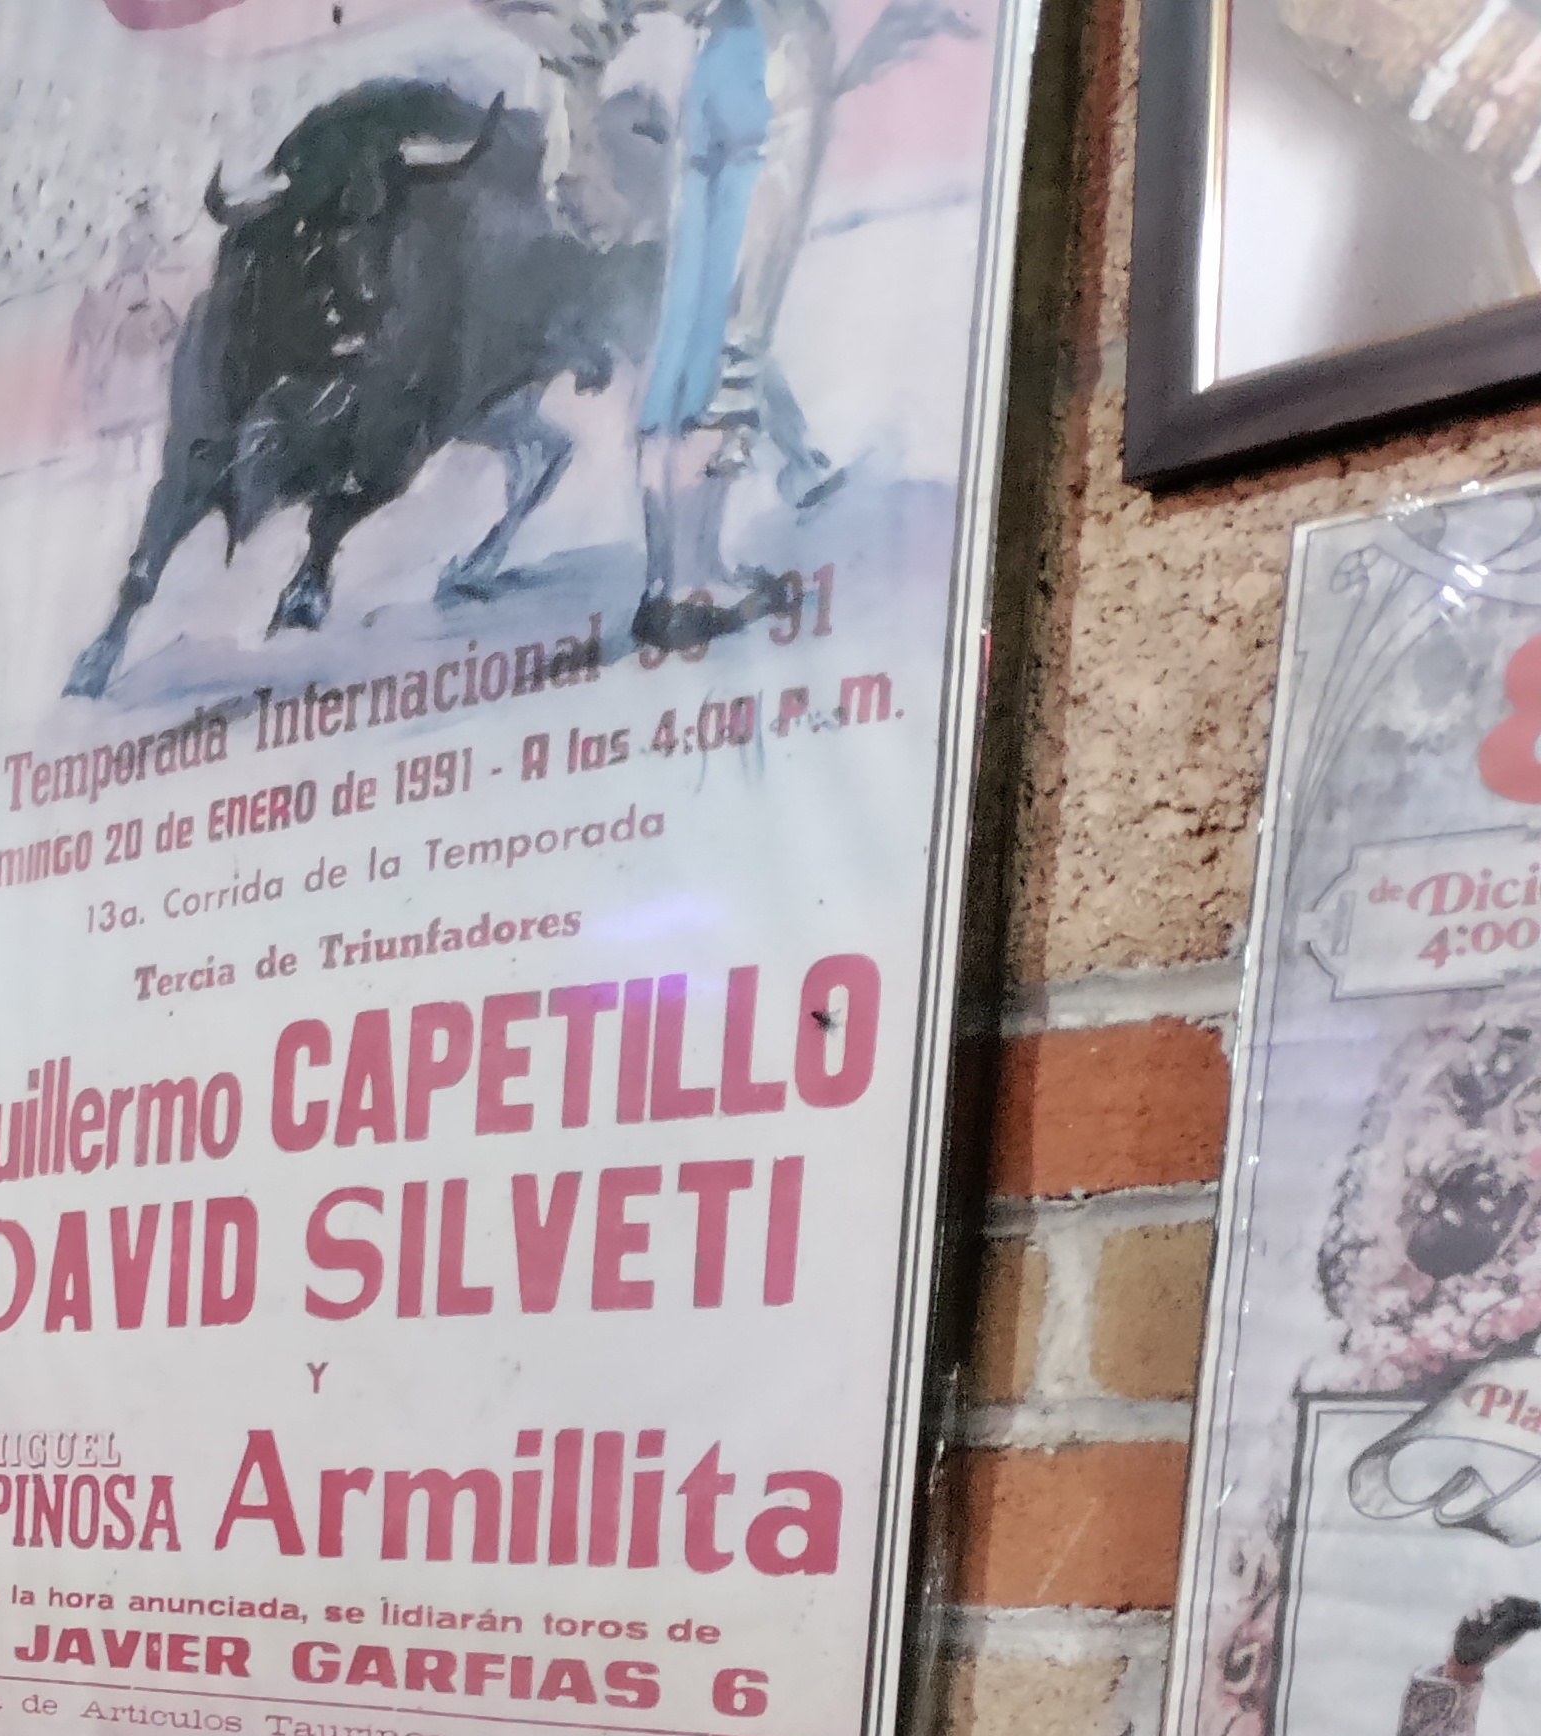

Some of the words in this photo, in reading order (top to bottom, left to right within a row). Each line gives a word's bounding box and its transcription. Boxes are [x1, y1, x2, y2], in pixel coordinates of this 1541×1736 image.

[4, 705, 229, 812] Temporada
[254, 610, 603, 752] Internacional
[103, 818, 144, 867] 20
[155, 811, 195, 854] de
[207, 778, 317, 842] ENERO
[331, 770, 378, 817] de
[395, 746, 473, 805] 1991
[520, 732, 551, 782] A
[566, 726, 631, 775] las
[650, 694, 756, 758] 4:00
[86, 899, 146, 933] 13a.
[163, 868, 284, 920] Corrida
[304, 856, 348, 895] de
[369, 846, 401, 882] la
[425, 802, 666, 871] Temporada
[1367, 875, 1405, 906] de
[1406, 861, 1541, 917] Dici
[133, 956, 235, 1002] Tercia
[255, 944, 298, 981] de
[318, 909, 583, 970] Triunfadores
[269, 951, 883, 1155] CAPETILLO
[303, 1154, 806, 1323] SILVETI
[305, 1361, 330, 1395] Y
[213, 1427, 844, 1577] Armillita
[10, 1584, 36, 1606] la
[48, 1586, 115, 1611] hora
[128, 1594, 309, 1625] anunciada,
[323, 1605, 366, 1626] se
[380, 1599, 524, 1635] lidiarán
[542, 1612, 649, 1642] toros
[667, 1617, 722, 1645] de
[13, 1623, 252, 1680] JAVIER
[291, 1639, 662, 1711] GARFIAS
[711, 1666, 771, 1719] 6
[20, 1693, 59, 1717] de
[79, 1700, 244, 1736] Articulos
